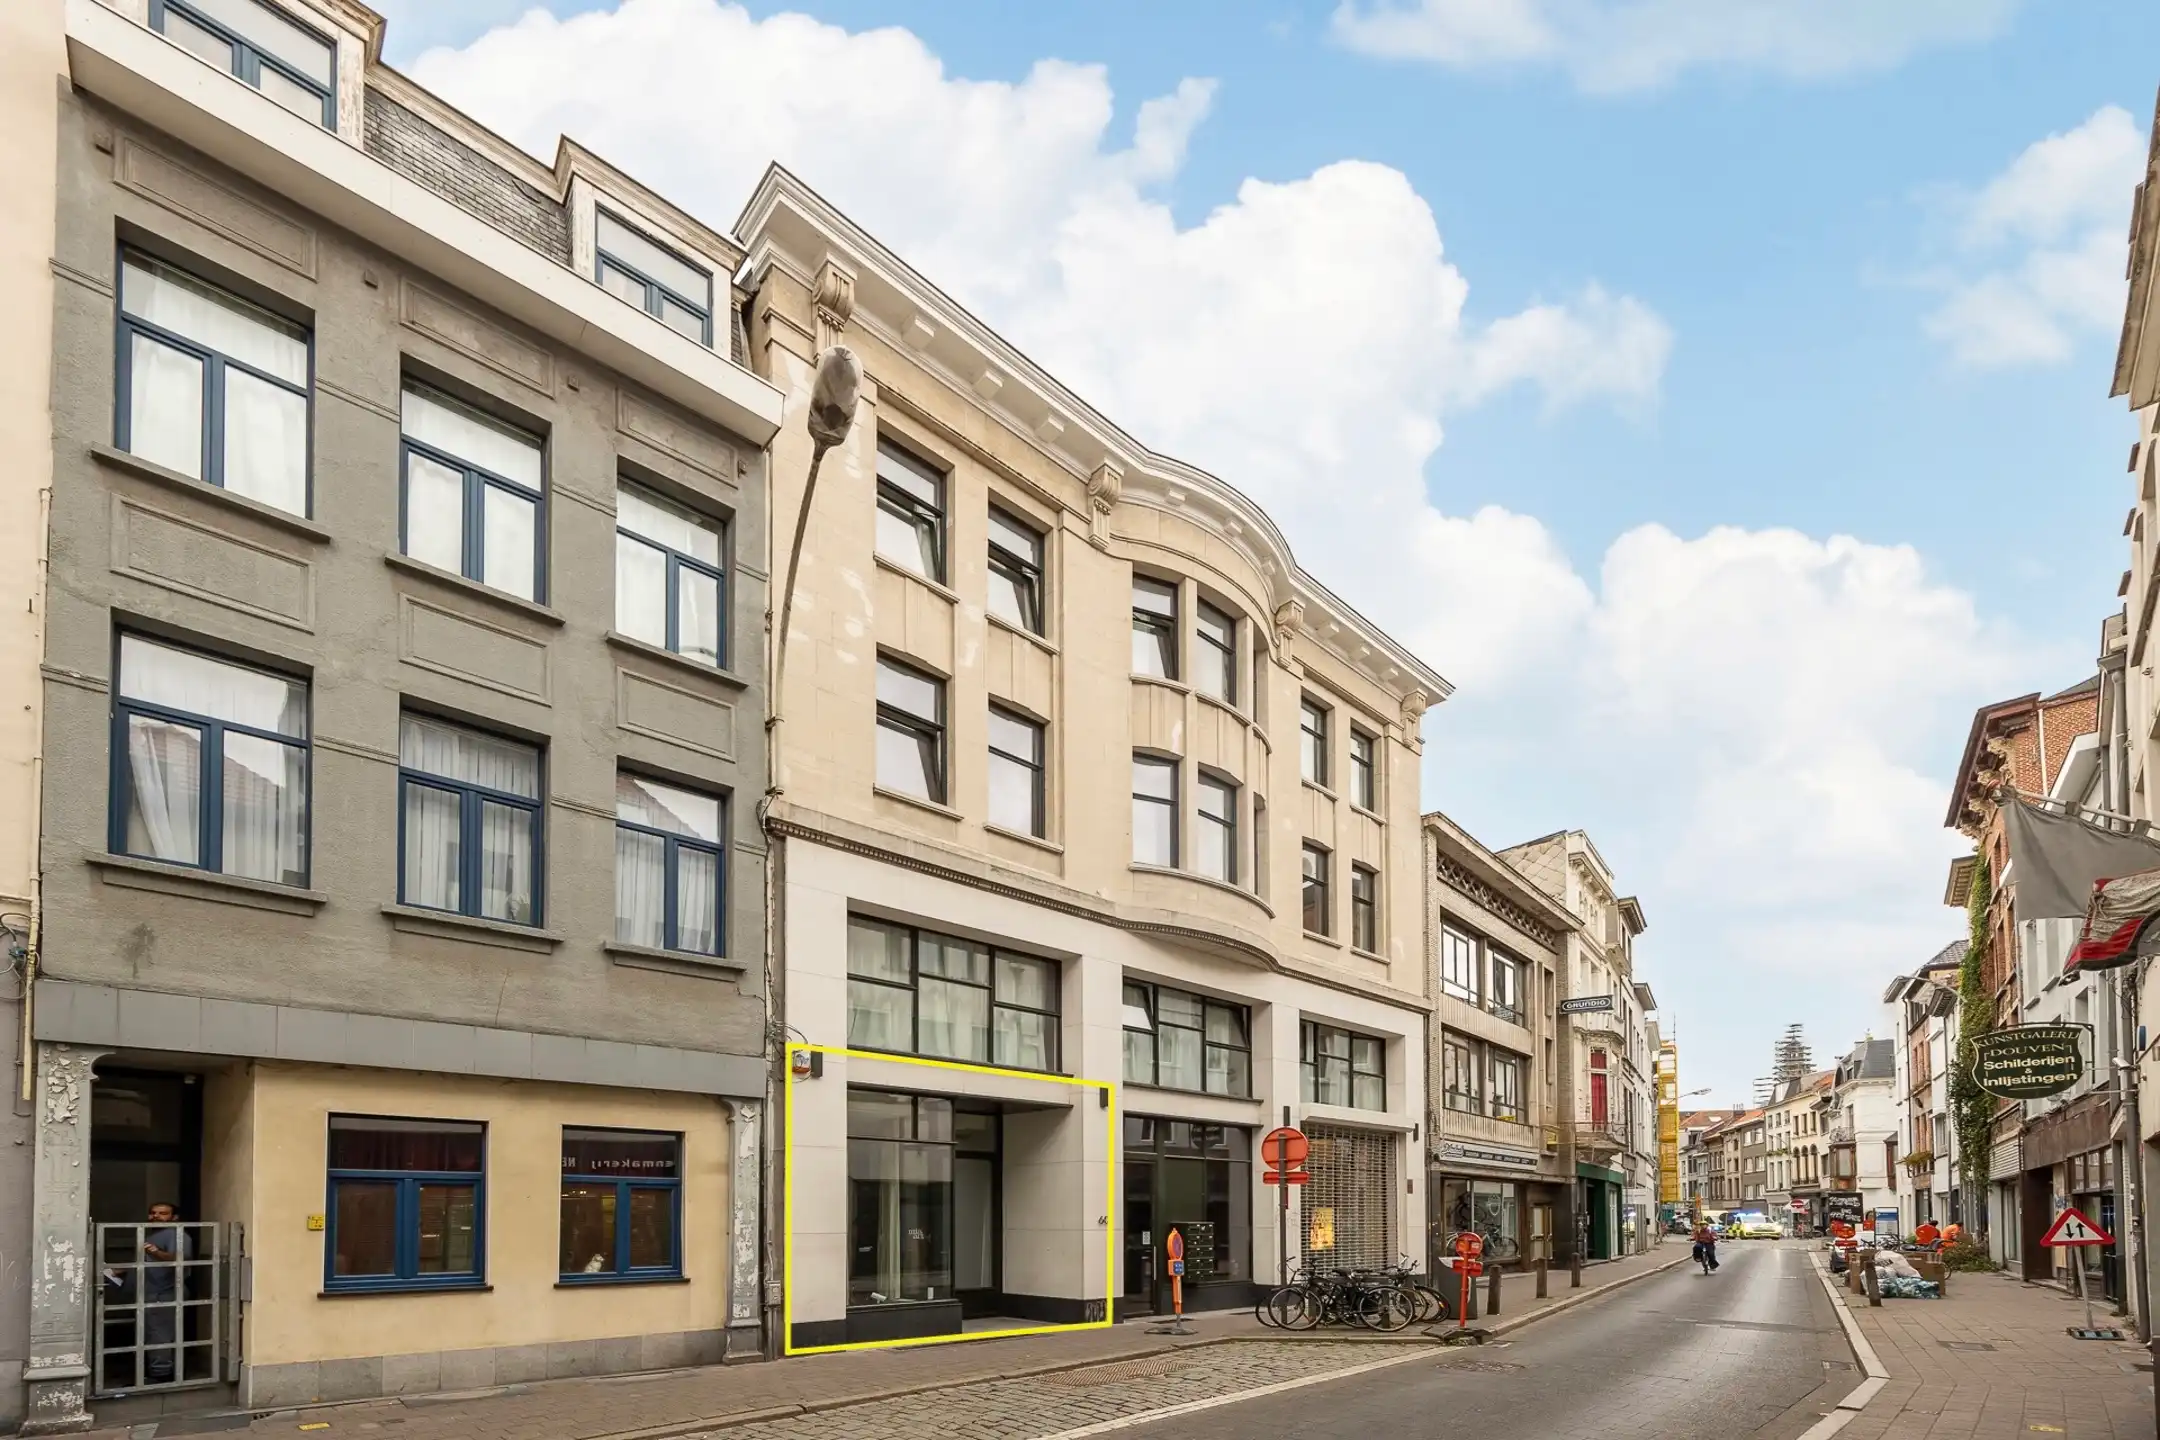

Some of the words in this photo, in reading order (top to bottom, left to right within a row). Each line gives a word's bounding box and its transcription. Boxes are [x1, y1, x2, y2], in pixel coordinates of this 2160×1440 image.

[1566, 999, 1606, 1009] GRUNDIG
[1975, 1030, 2080, 1048] KUNSTGALERIJ
[1990, 1043, 2065, 1057] DOUVEN
[1983, 1055, 2075, 1070] Schilderijen
[1983, 1072, 2078, 1087] Inlijstingen
